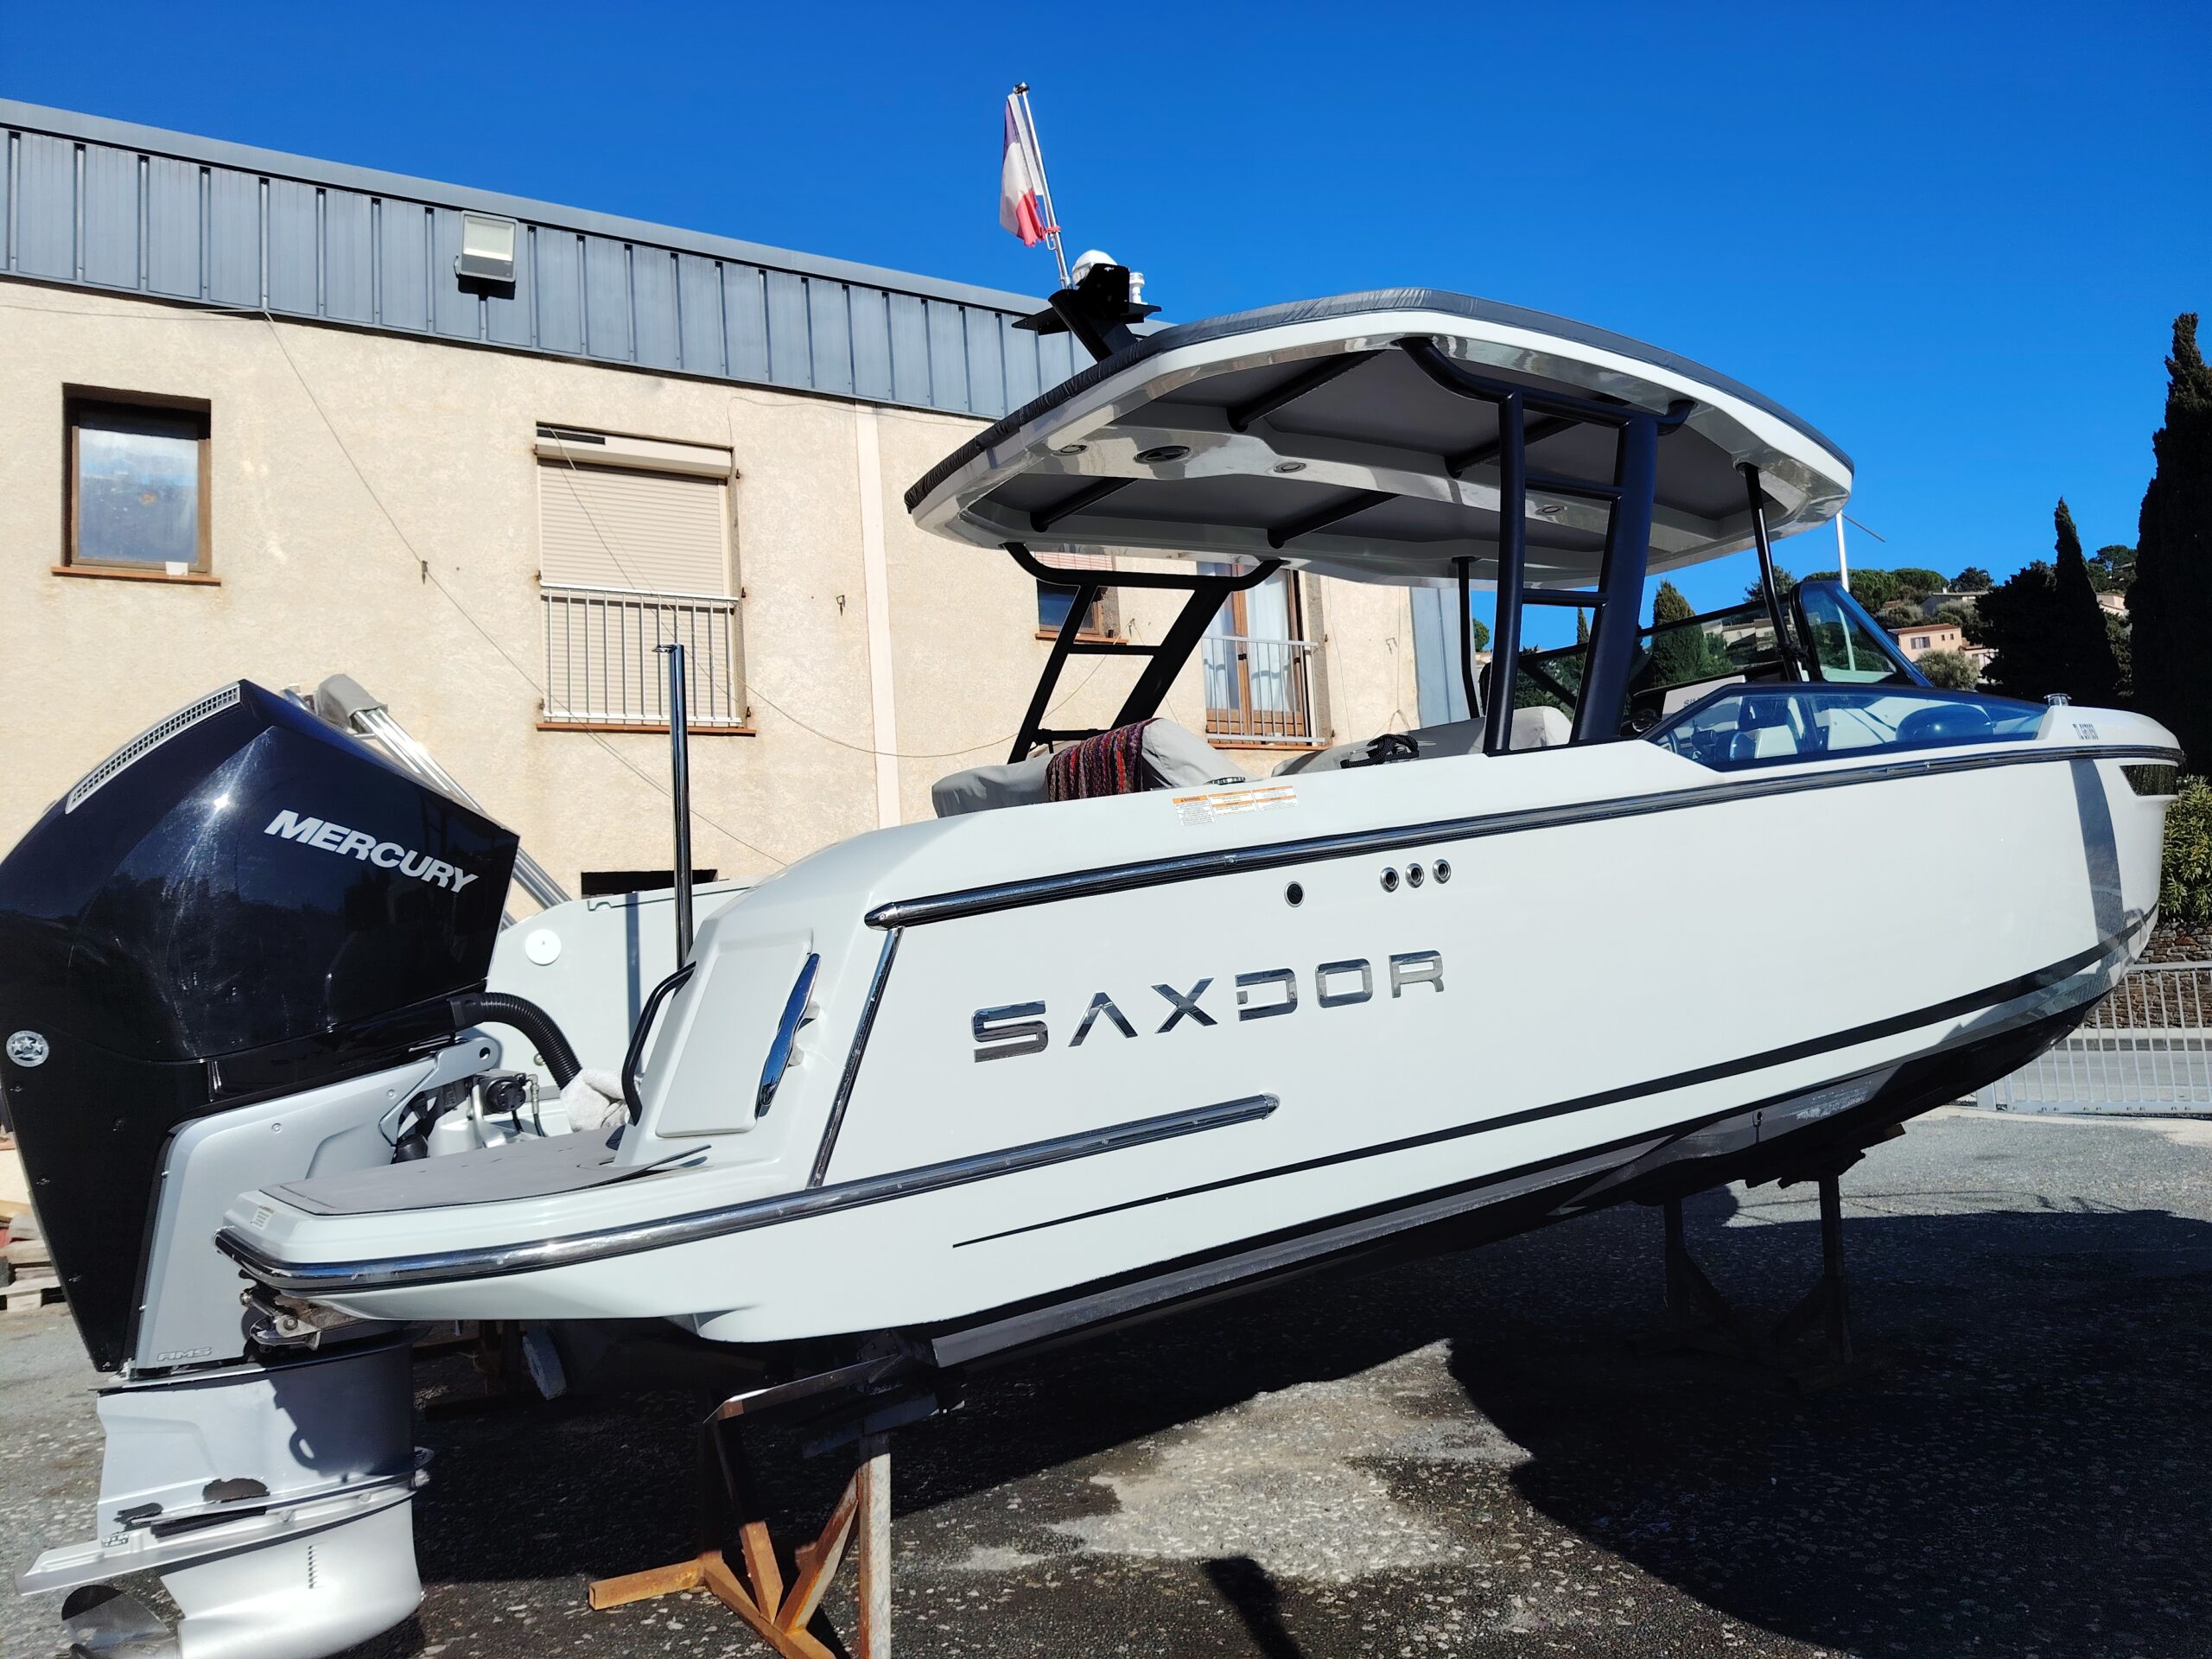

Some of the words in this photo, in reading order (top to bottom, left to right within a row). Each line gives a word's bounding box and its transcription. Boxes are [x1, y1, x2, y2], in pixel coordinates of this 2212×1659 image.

[264, 809, 480, 893] MERCURY
[971, 950, 1445, 1063] SAXDOR
[157, 1347, 213, 1362] AMS
